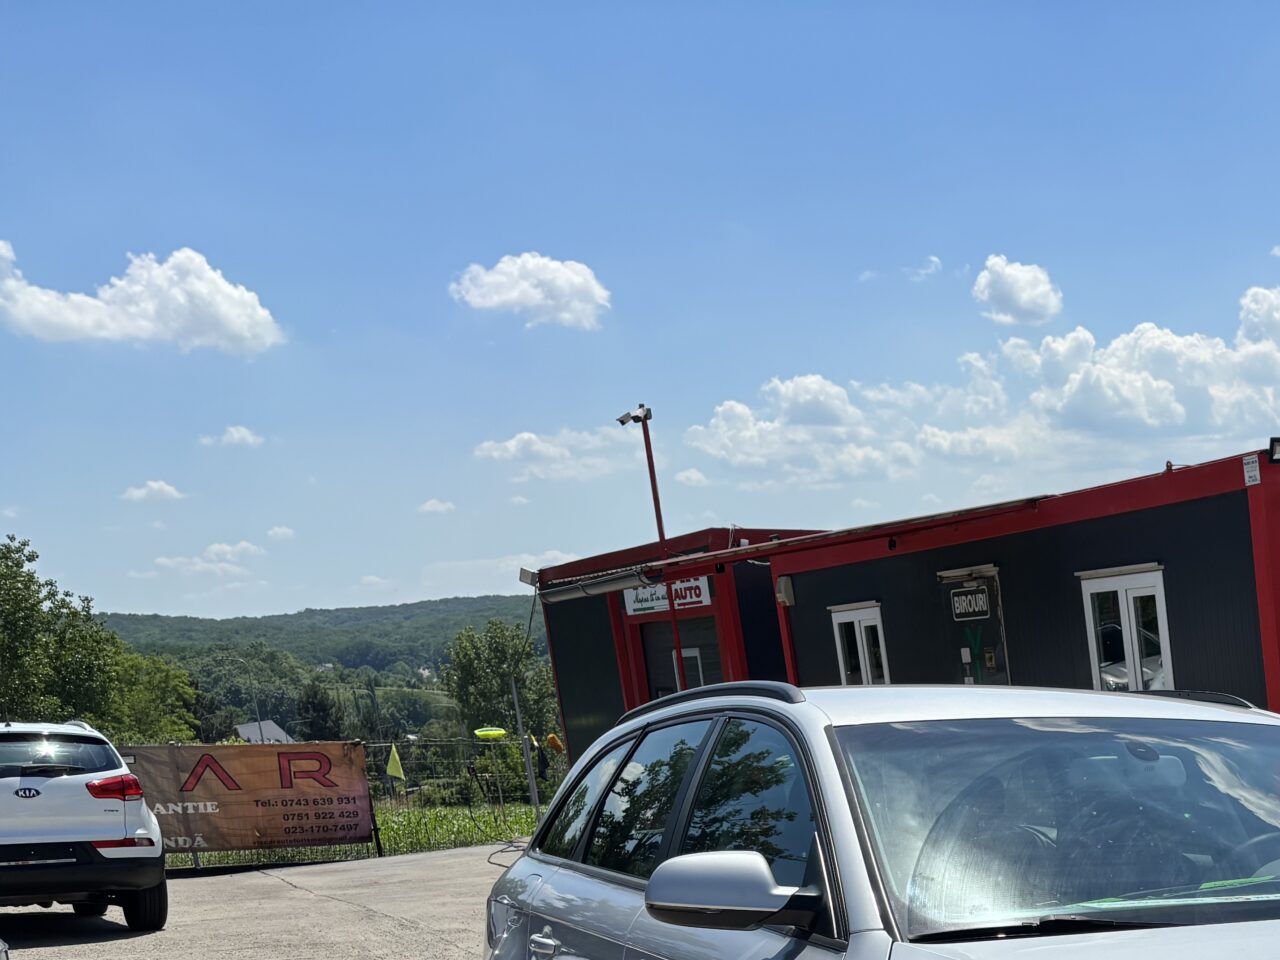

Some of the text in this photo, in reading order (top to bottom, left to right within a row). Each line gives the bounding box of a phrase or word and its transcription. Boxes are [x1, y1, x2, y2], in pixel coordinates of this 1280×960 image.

[673, 585, 702, 602] AUTO
[953, 594, 988, 614] BIROURI
[18, 789, 38, 797] KIA
[254, 796, 357, 808] Tel.: 0743 639 931
[152, 802, 220, 815] ANTIE
[282, 810, 359, 822] 0751 922 429
